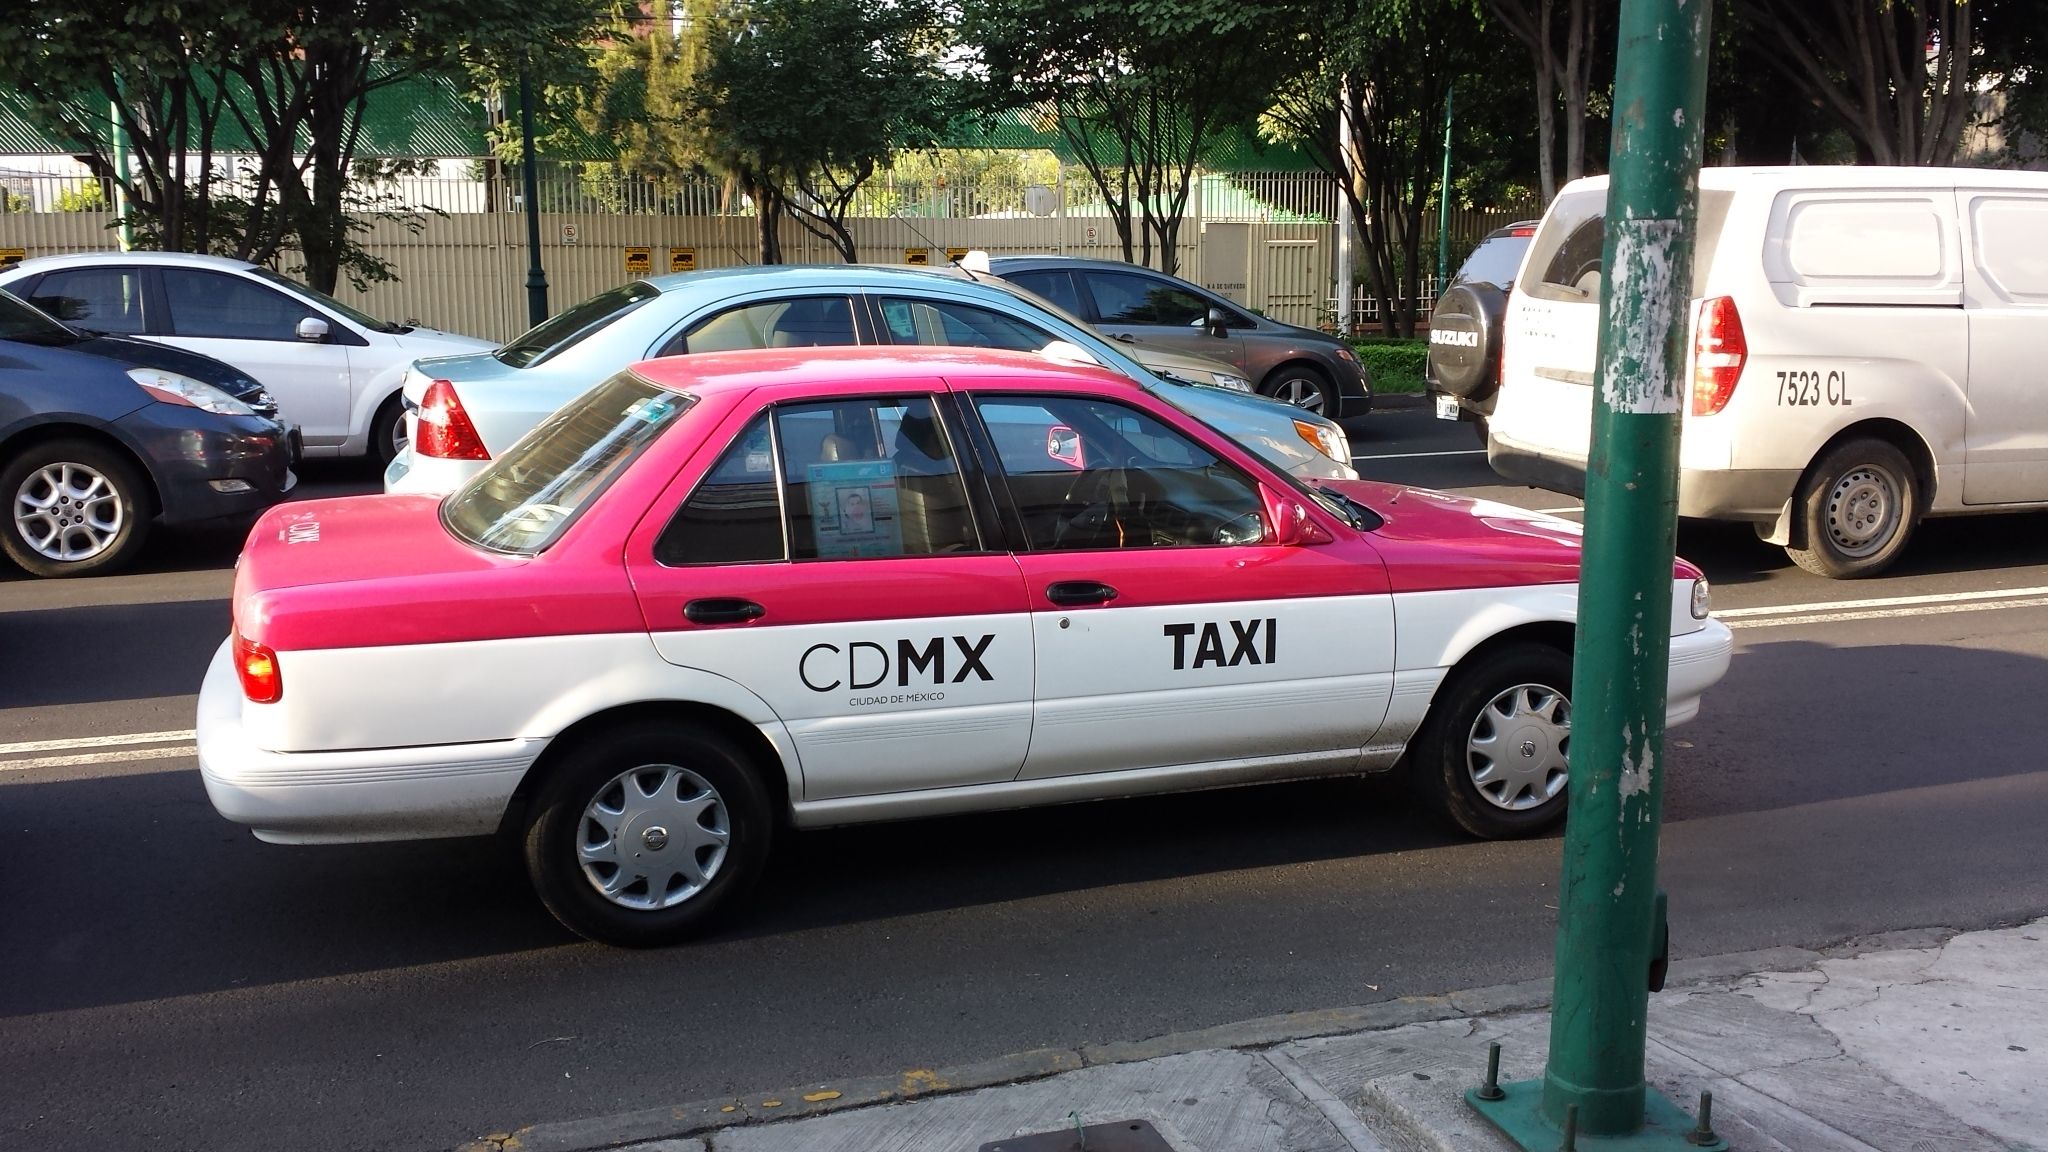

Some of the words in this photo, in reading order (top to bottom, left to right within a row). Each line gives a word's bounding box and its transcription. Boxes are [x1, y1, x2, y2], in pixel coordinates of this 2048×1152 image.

[1430, 329, 1478, 347] SUZUKI
[1776, 370, 1820, 406] 7523
[1827, 370, 1852, 406] CL
[1163, 618, 1277, 670] TAXI
[798, 634, 996, 693] CDMX
[849, 697, 888, 707] CIUDAD
[890, 694, 903, 704] DE
